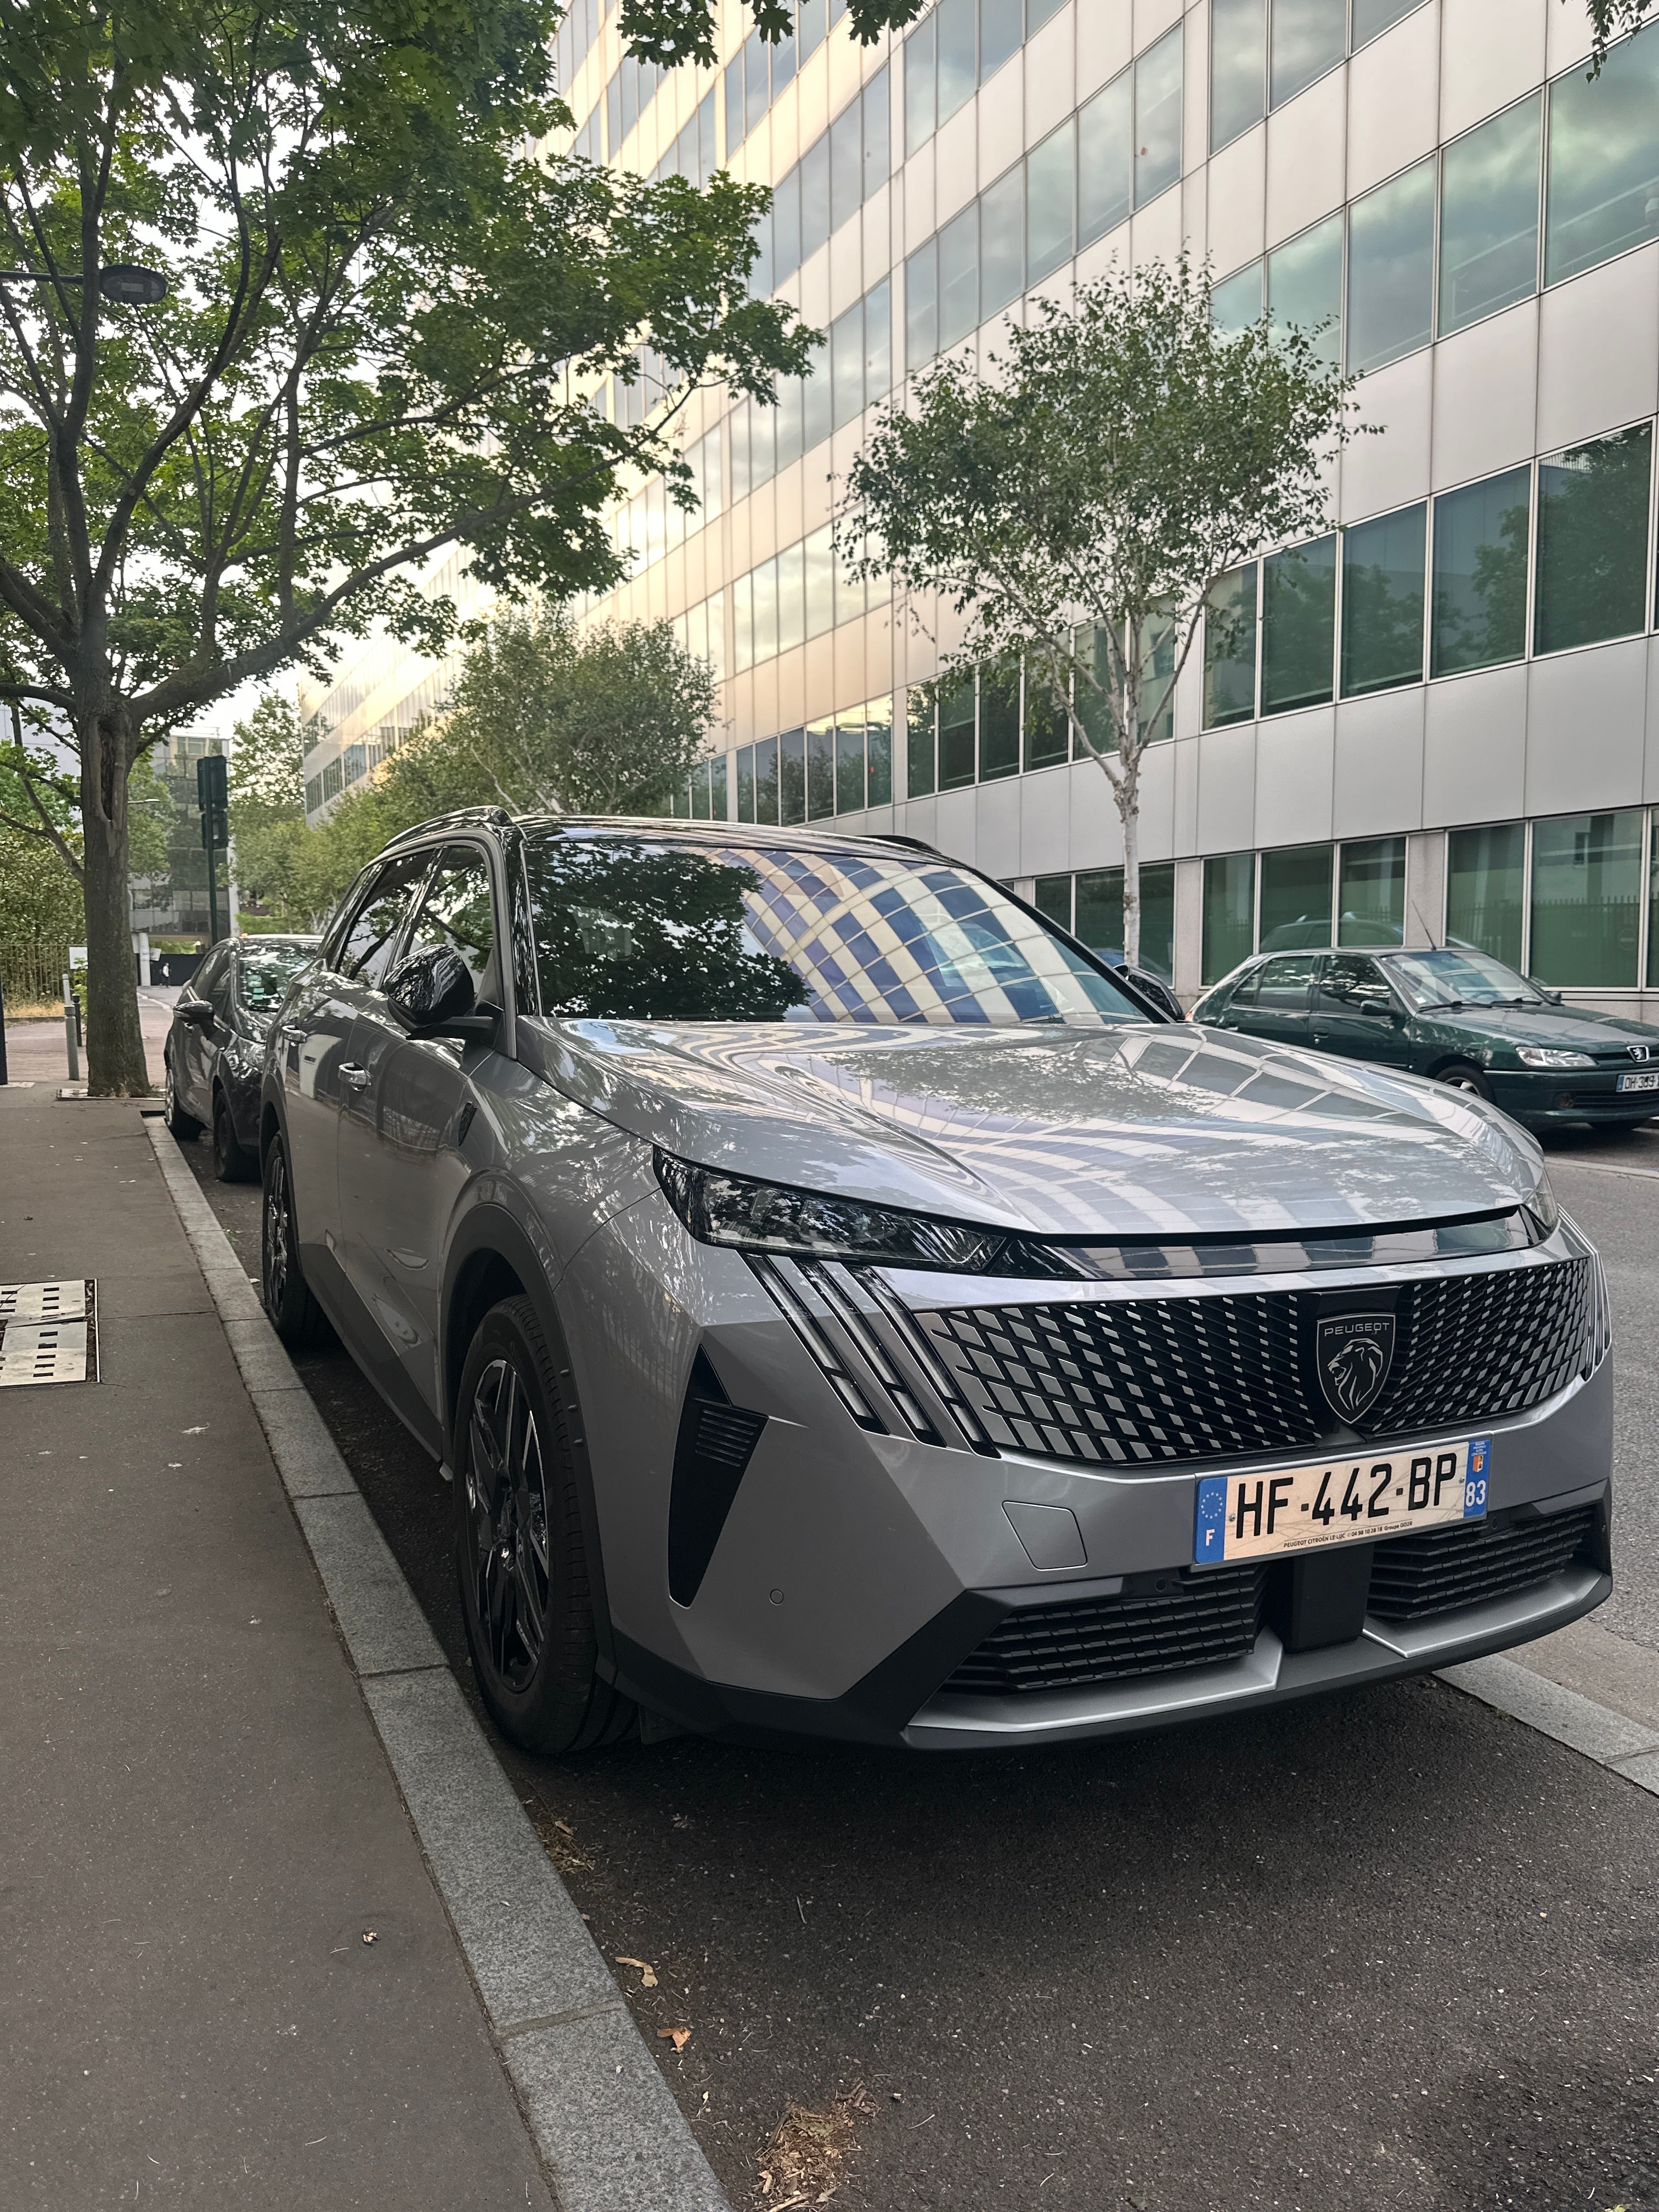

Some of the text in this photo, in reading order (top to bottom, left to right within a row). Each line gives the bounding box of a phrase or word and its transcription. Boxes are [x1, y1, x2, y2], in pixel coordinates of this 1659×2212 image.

[1324, 1322, 1390, 1337] PEUGEOT
[1465, 1480, 1486, 1507] 83
[1205, 1528, 1215, 1546] F
[1283, 1539, 1307, 1548] PEUGEOT
